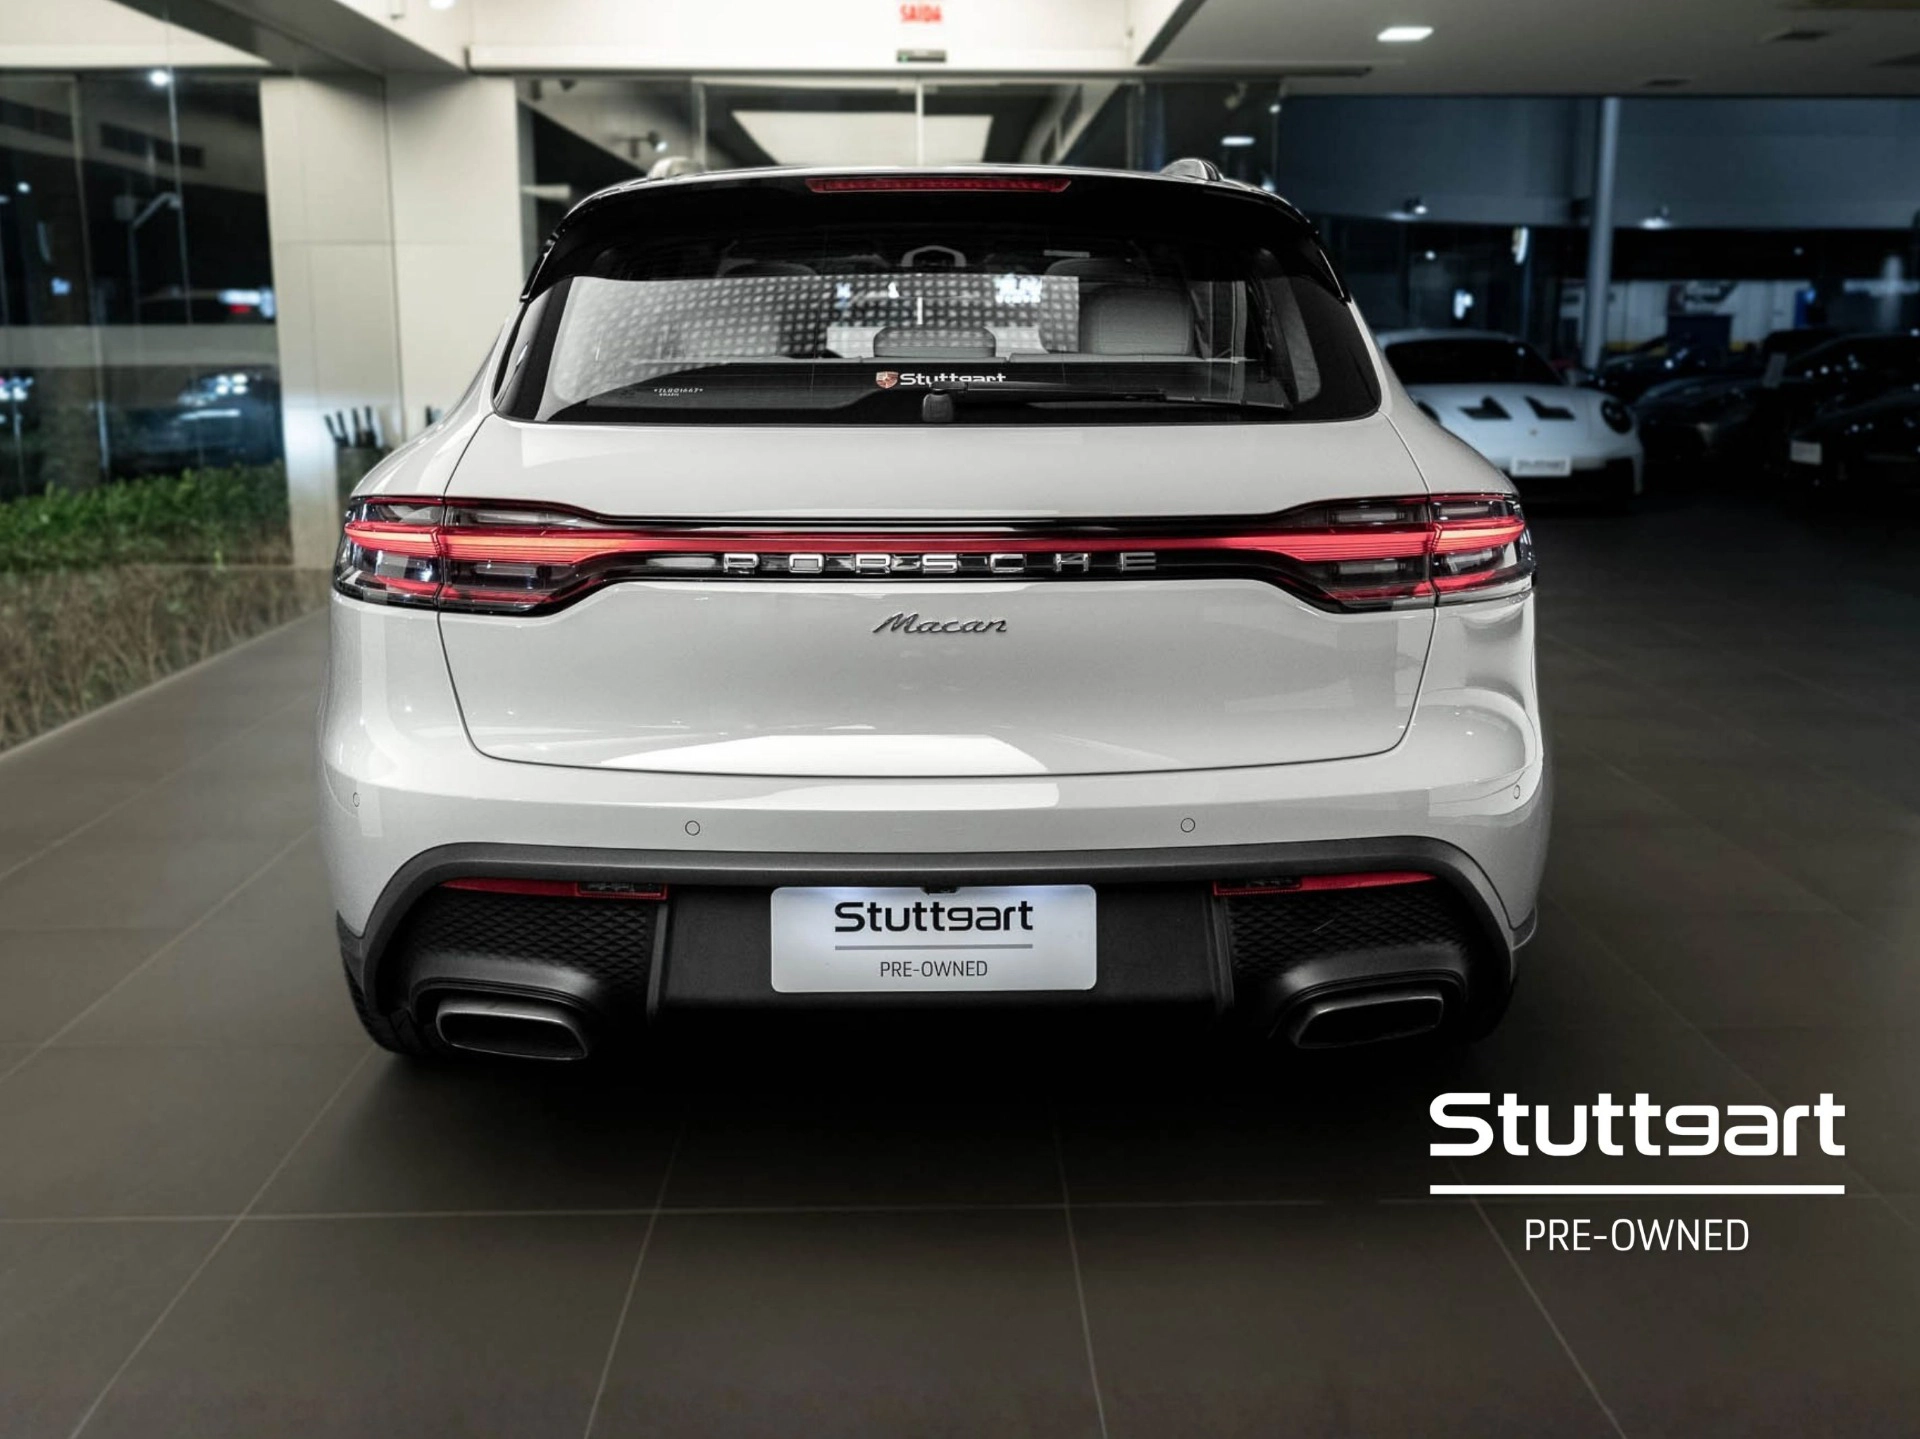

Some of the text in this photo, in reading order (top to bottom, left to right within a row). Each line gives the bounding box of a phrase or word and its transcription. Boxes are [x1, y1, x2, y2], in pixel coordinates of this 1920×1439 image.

[722, 552, 1157, 575] PORSCHE
[872, 611, 1008, 635] Macan
[834, 900, 1034, 933] Stuttgart
[879, 960, 988, 978] PRE-OWNED
